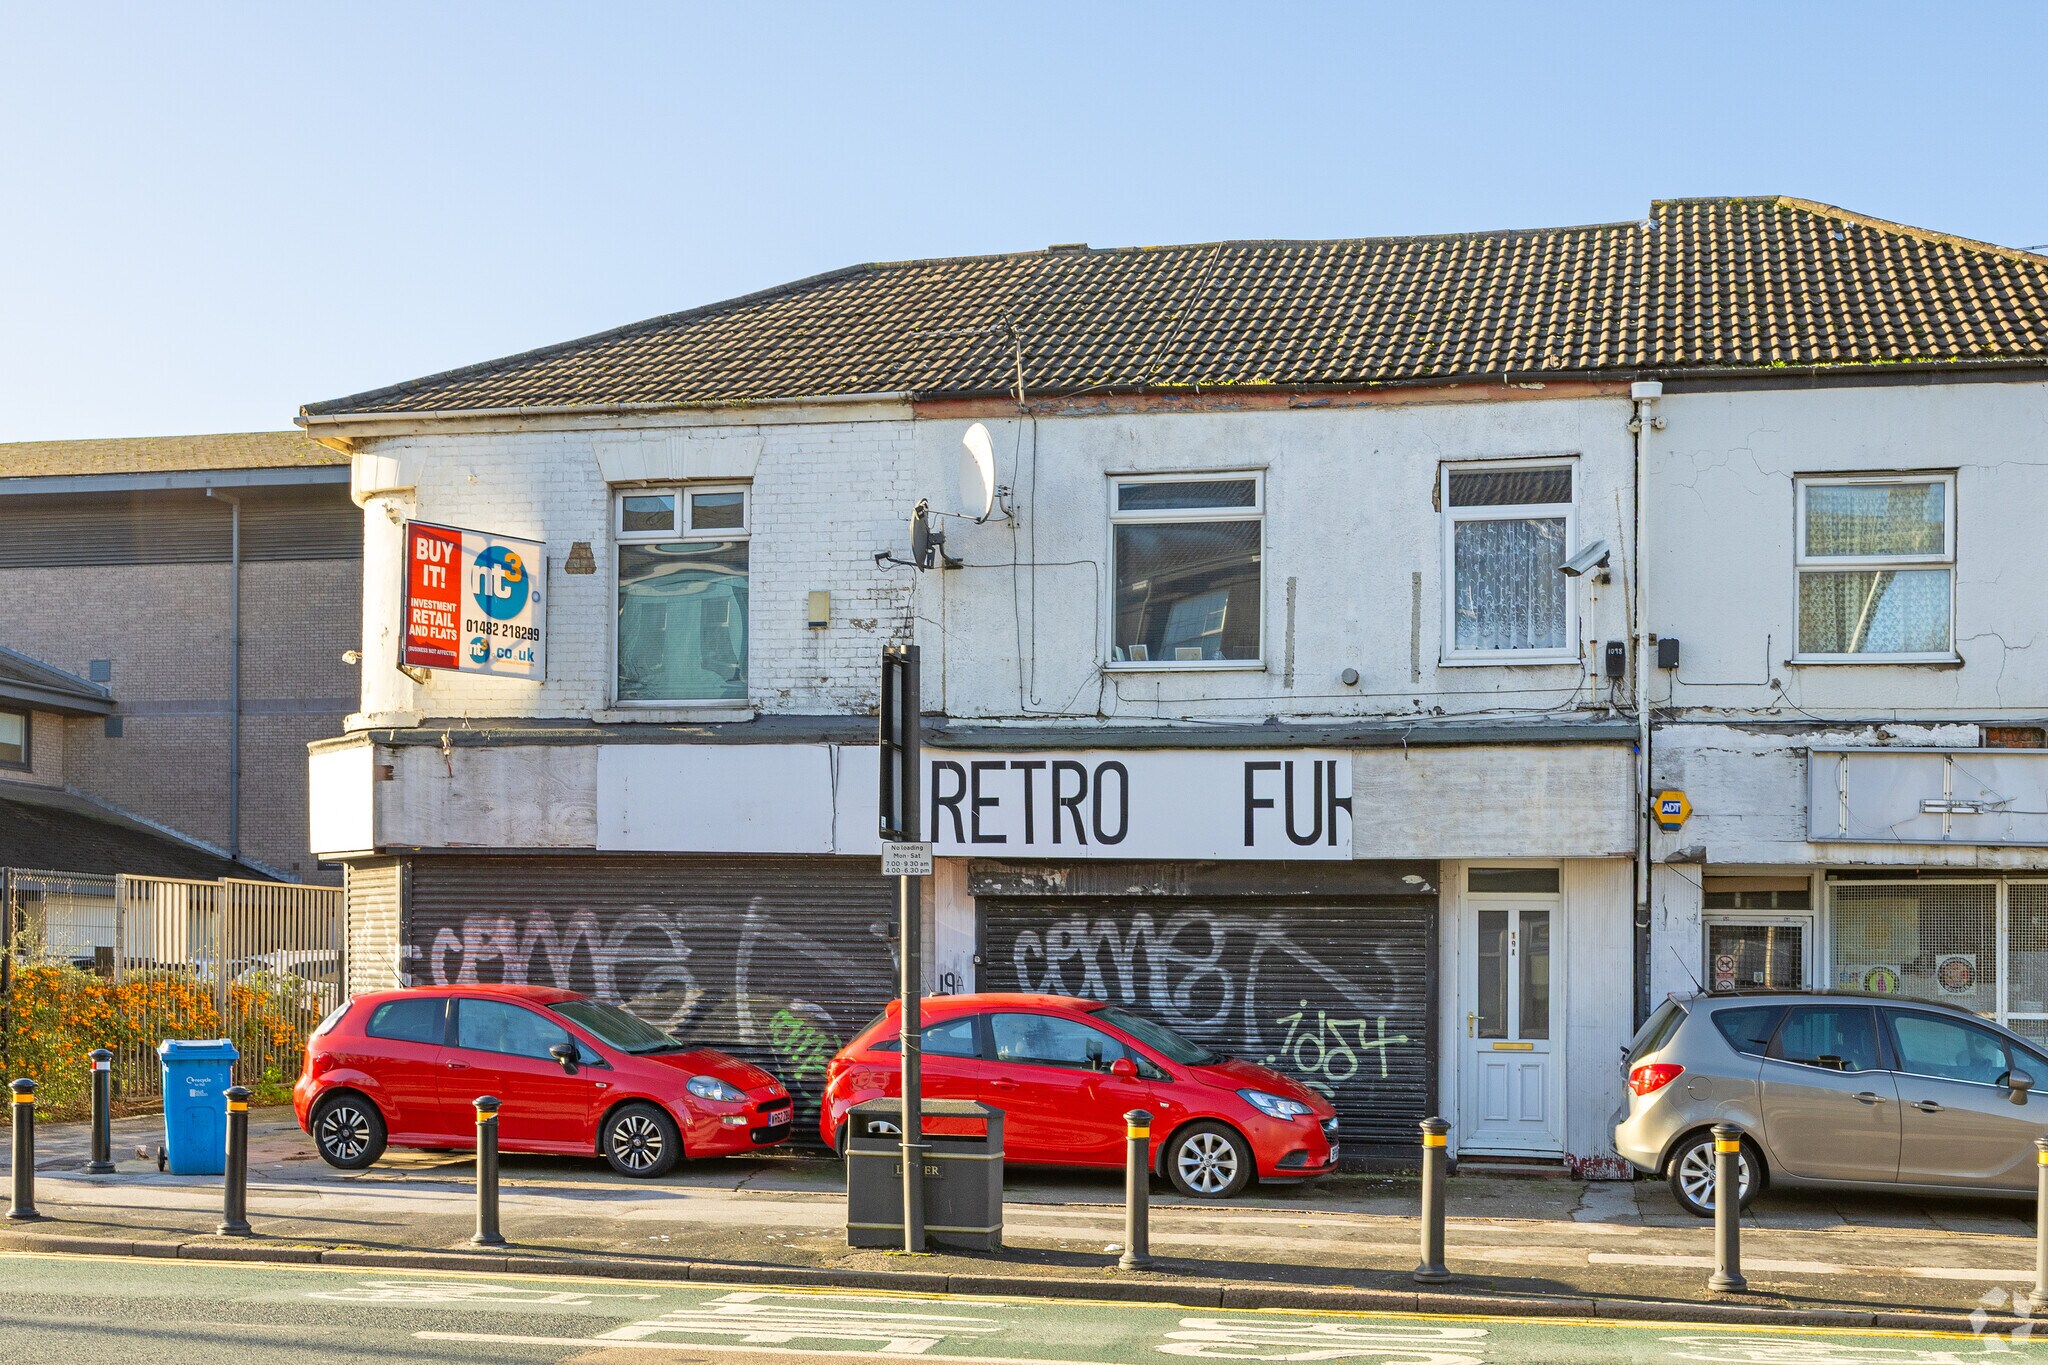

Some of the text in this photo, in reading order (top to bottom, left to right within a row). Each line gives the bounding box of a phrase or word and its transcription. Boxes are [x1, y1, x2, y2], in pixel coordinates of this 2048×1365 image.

[416, 537, 454, 564] BUY
[422, 564, 446, 589] IT!
[411, 597, 457, 612] INVESTMENT
[413, 608, 455, 628] RETAIL
[408, 623, 458, 641] AND FLATS
[466, 619, 540, 641] 01482 218299
[931, 760, 1128, 846] RETRO
[1662, 802, 1681, 813] ADT
[901, 844, 923, 852] loading
[896, 1165, 939, 1176] LER
